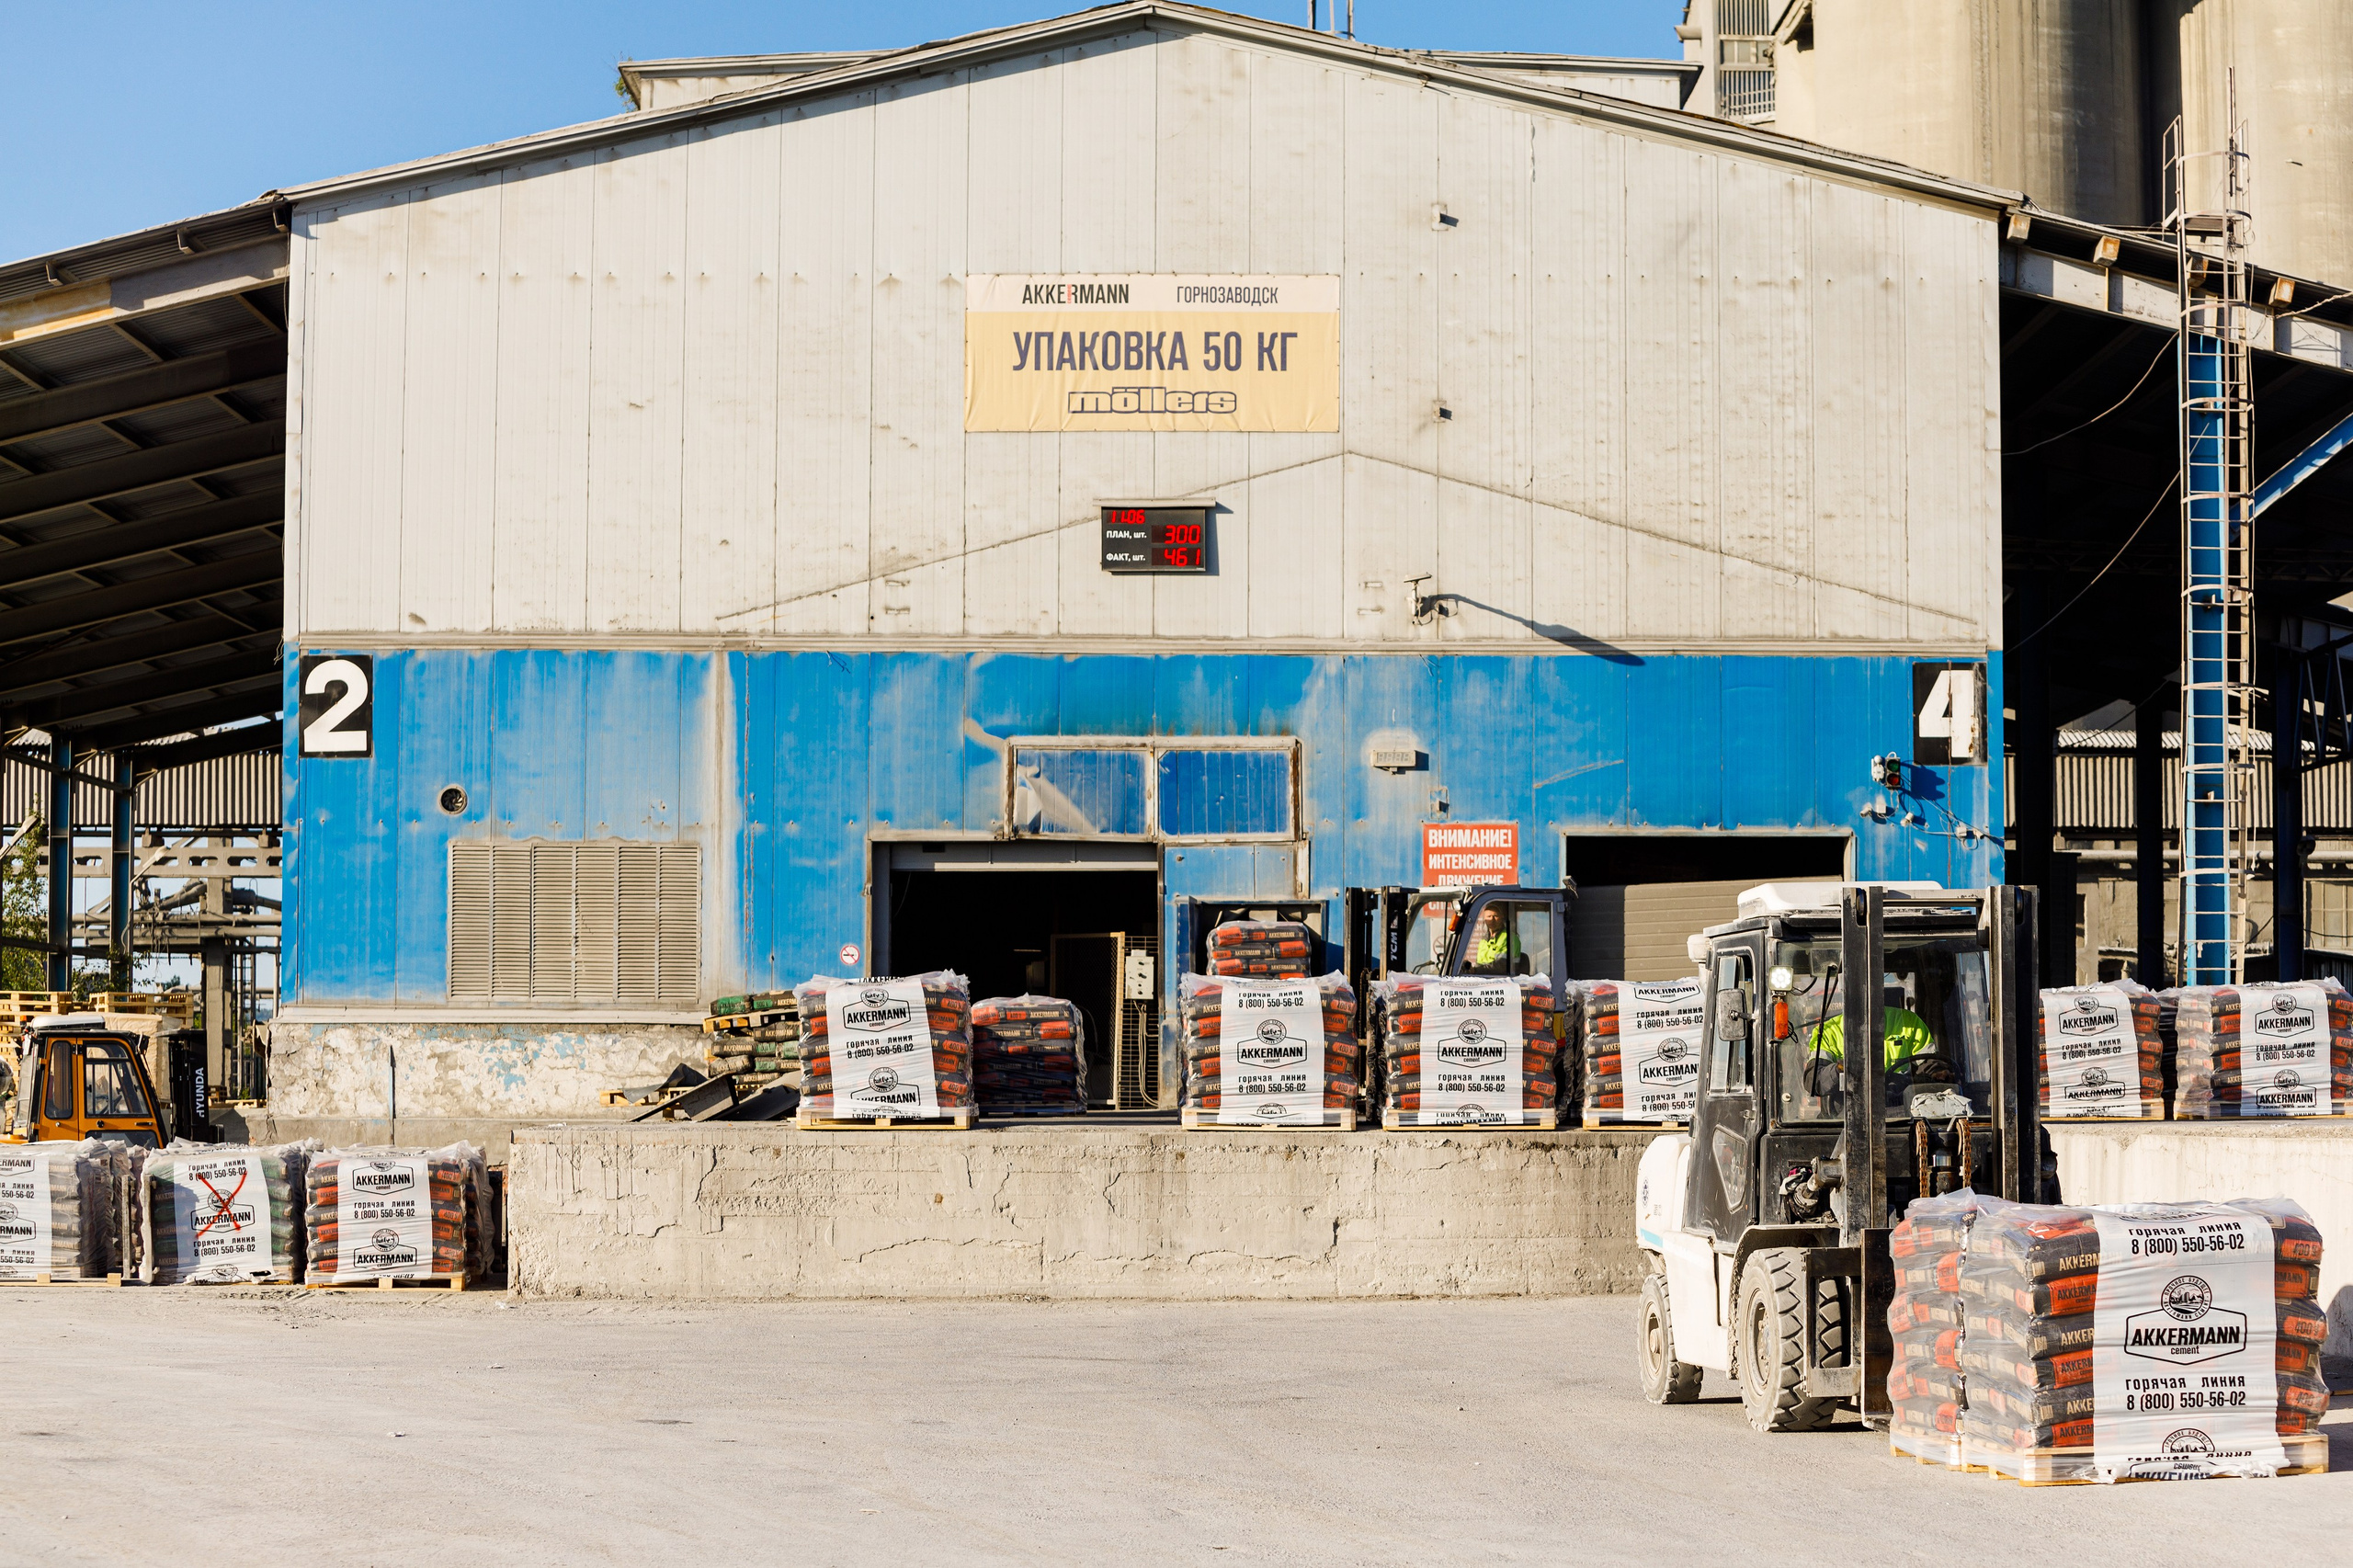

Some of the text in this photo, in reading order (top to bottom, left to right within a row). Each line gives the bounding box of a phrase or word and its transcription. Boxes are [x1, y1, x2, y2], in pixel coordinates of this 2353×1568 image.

[1022, 283, 1130, 304] AKKERMANN
[1176, 286, 1279, 306] ГОРНОЗАВОДСК
[1012, 331, 1299, 372] УПАКОВКА 50 КГ
[1068, 386, 1237, 414] möllers
[1106, 530, 1132, 540] ПЛАН,
[1165, 525, 1201, 544] 300
[1106, 553, 1131, 562] ФАКТ,
[1164, 547, 1201, 567] 461
[304, 659, 369, 752] 2
[1919, 670, 1978, 758] 4
[1428, 829, 1513, 847] ВНИМАНИЕ!
[1428, 854, 1512, 869] ИНТЕНСИВНОЕ
[1238, 997, 1303, 1009] 8 (800) 550-56-02
[1440, 997, 1505, 1008] 8 (800) 550-56-02
[847, 1008, 906, 1025] AKKERMANN
[1636, 1006, 1703, 1018] горячая линия
[1637, 1016, 1703, 1029] 8 (800) 550-56-02
[2063, 1014, 2115, 1028] AKKERMANN
[2258, 1017, 2311, 1029] AKKERMANN
[847, 1035, 913, 1050] горячая линия
[2062, 1041, 2092, 1051] горячая
[847, 1044, 915, 1059] 8 (800) 550-56-02
[1241, 1046, 1303, 1059] AKKERMANN
[1441, 1047, 1503, 1057] AKKERMANN
[2068, 1051, 2086, 1061] (800)
[2088, 1046, 2121, 1057] 550-56-02
[2263, 1051, 2279, 1062] (800)
[2282, 1050, 2315, 1059] 550-56-02
[1643, 1064, 1699, 1078] AKKERMAN
[1238, 1074, 1306, 1084] горячая линия
[1438, 1074, 1472, 1083] горячая
[1238, 1083, 1306, 1094] 8 (800) 550-56-02
[1438, 1083, 1506, 1093] 8 (800) 550-56-02
[1642, 1093, 1676, 1103] горячая
[2259, 1093, 2313, 1104] AKKERMANN
[1650, 1103, 1669, 1112] (800)
[356, 1174, 411, 1186] AKKERMANN
[2, 1190, 35, 1199] 550-56-02
[354, 1199, 415, 1210] горячая линия
[194, 1211, 251, 1226] AKKERMANN
[354, 1209, 415, 1220] 8 (800) 550-56-02
[2129, 1221, 2242, 1238] горячая линия
[193, 1238, 224, 1248] горячая
[2131, 1233, 2245, 1256] 8 (800) 550-56-02
[194, 1244, 256, 1257] 8 (800) 550-56-02
[357, 1255, 414, 1264] AKKERMANN
[2131, 1326, 2240, 1346] AKKERMANN
[2170, 1345, 2200, 1355] cement
[2125, 1376, 2245, 1393] горячая линия
[2127, 1391, 2246, 1412] 8 (800) 550-56-02
